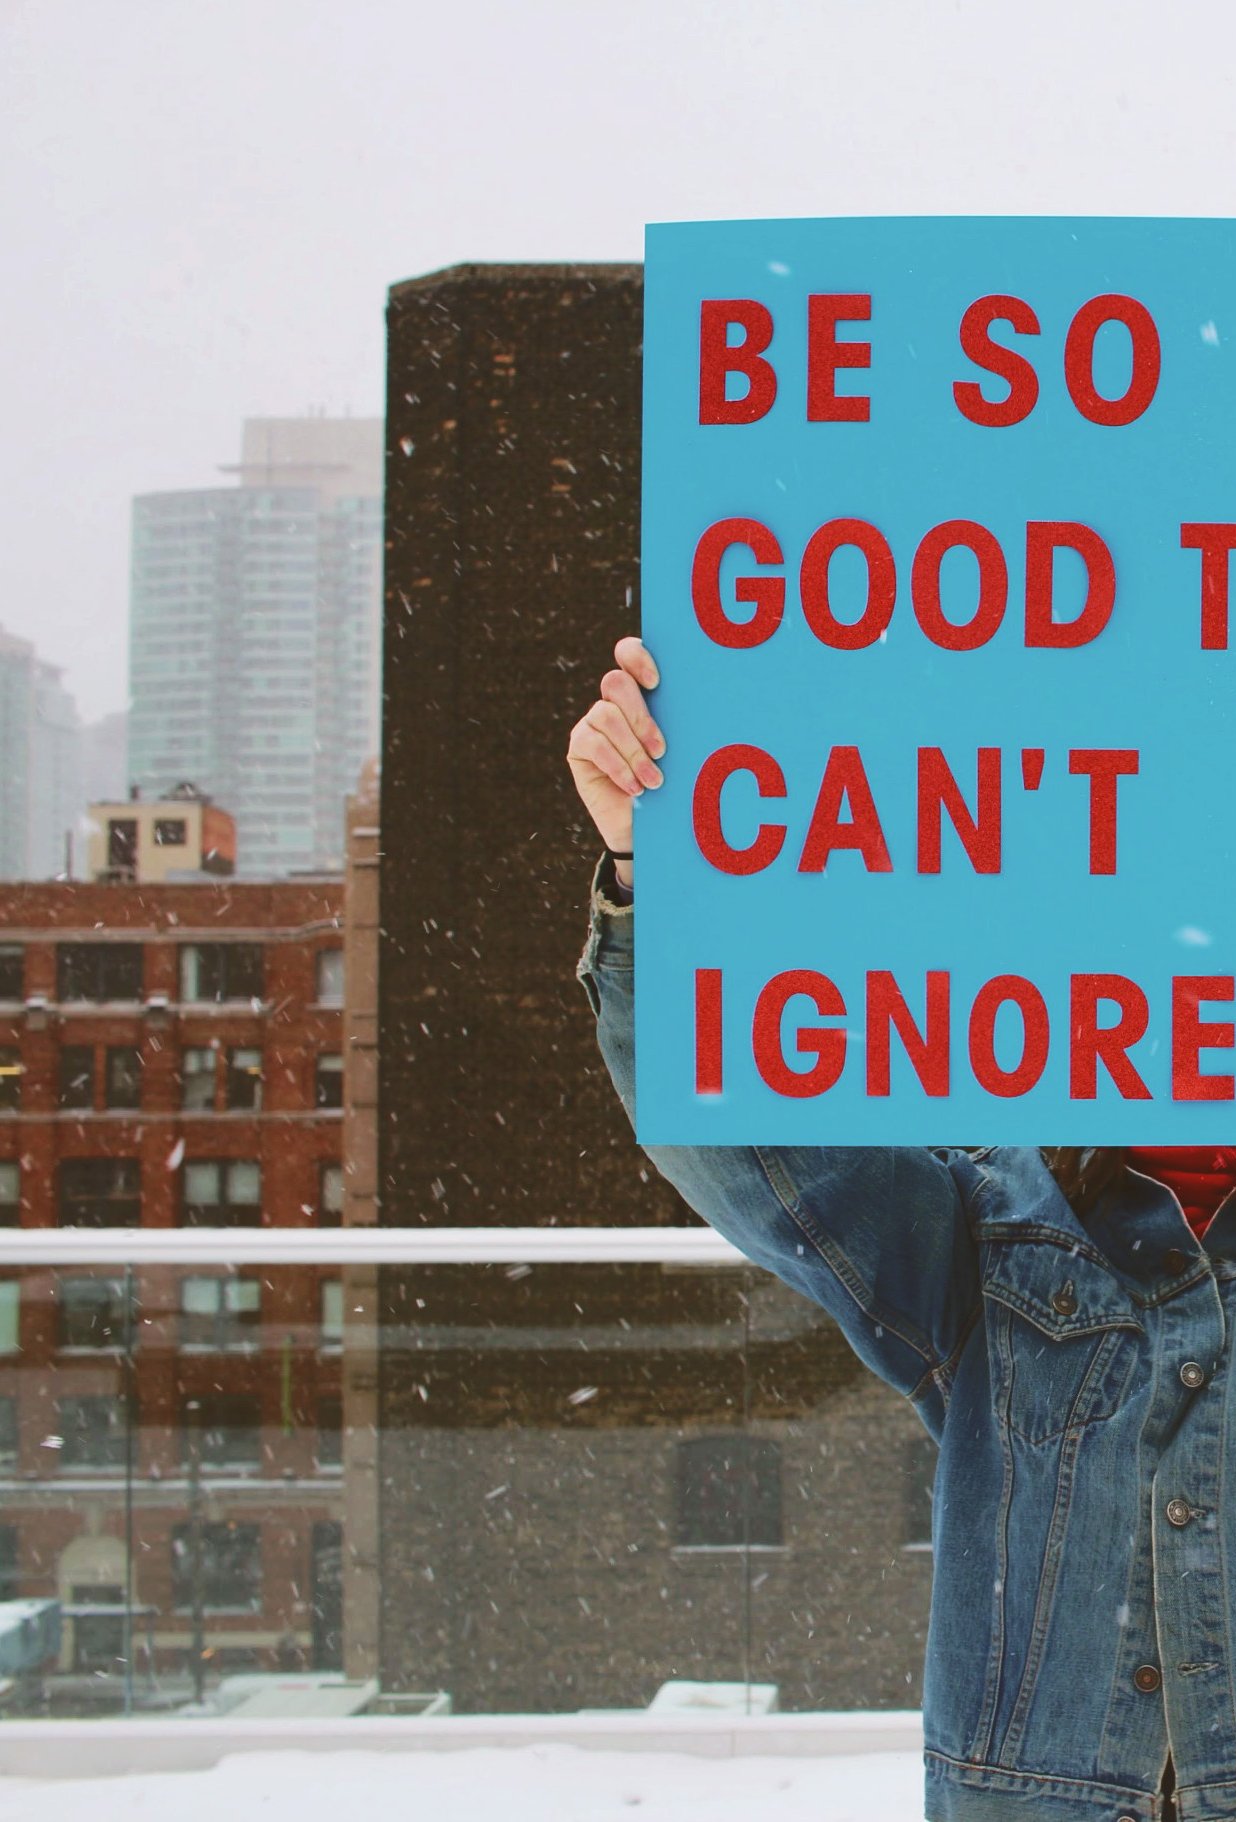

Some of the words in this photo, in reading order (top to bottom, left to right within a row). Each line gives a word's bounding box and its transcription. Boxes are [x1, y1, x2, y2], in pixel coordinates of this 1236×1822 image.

[699, 292, 873, 427] BE
[952, 294, 1162, 427] SO
[691, 518, 1116, 651] GOOD
[692, 744, 1140, 876] CAN'T
[695, 968, 1236, 1102] IGNORE
